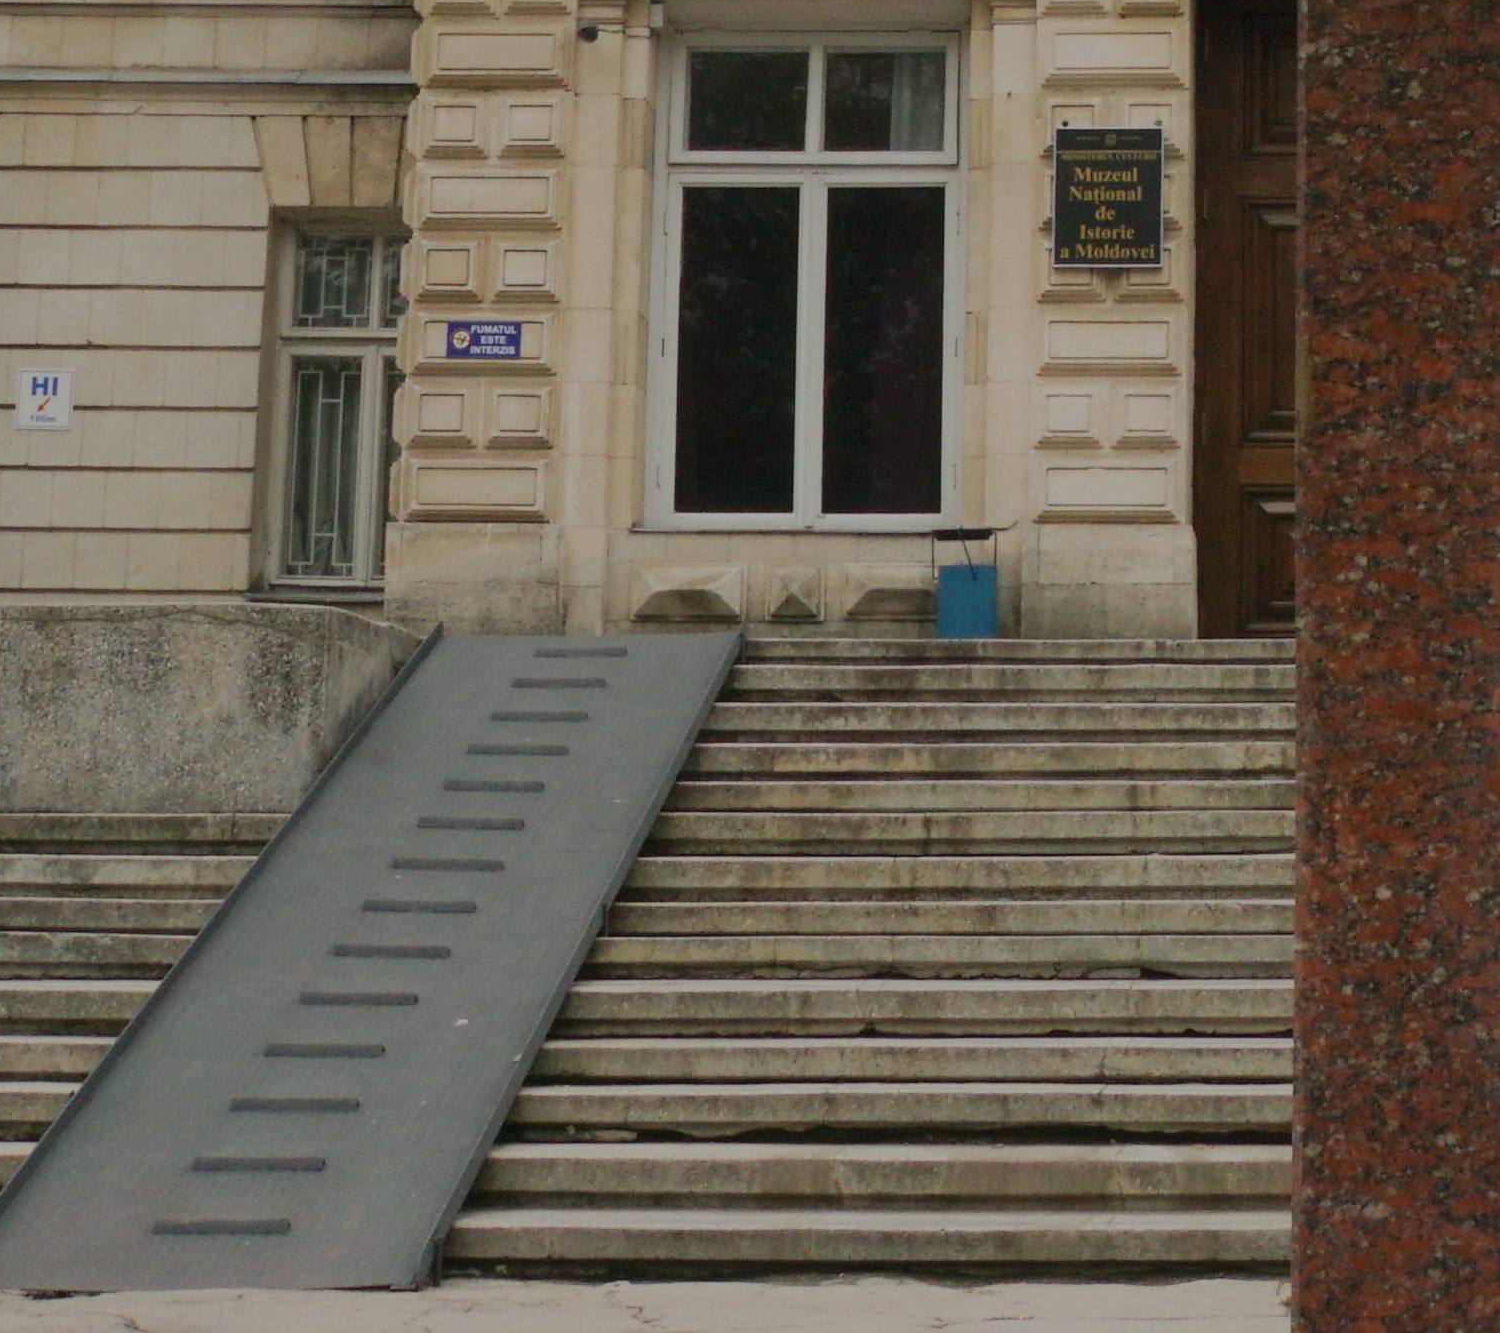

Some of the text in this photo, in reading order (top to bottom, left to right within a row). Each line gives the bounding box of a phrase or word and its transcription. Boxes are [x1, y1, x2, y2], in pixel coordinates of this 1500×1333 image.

[1074, 167, 1138, 182] Muzeul
[1095, 206, 1115, 221] de
[1080, 224, 1135, 239] Istorie
[1060, 244, 1155, 259] a Moldovei
[471, 325, 516, 334] FUMATUL
[481, 336, 506, 344] ESTE
[470, 346, 515, 354] INTERZIS
[31, 376, 58, 396] HI
